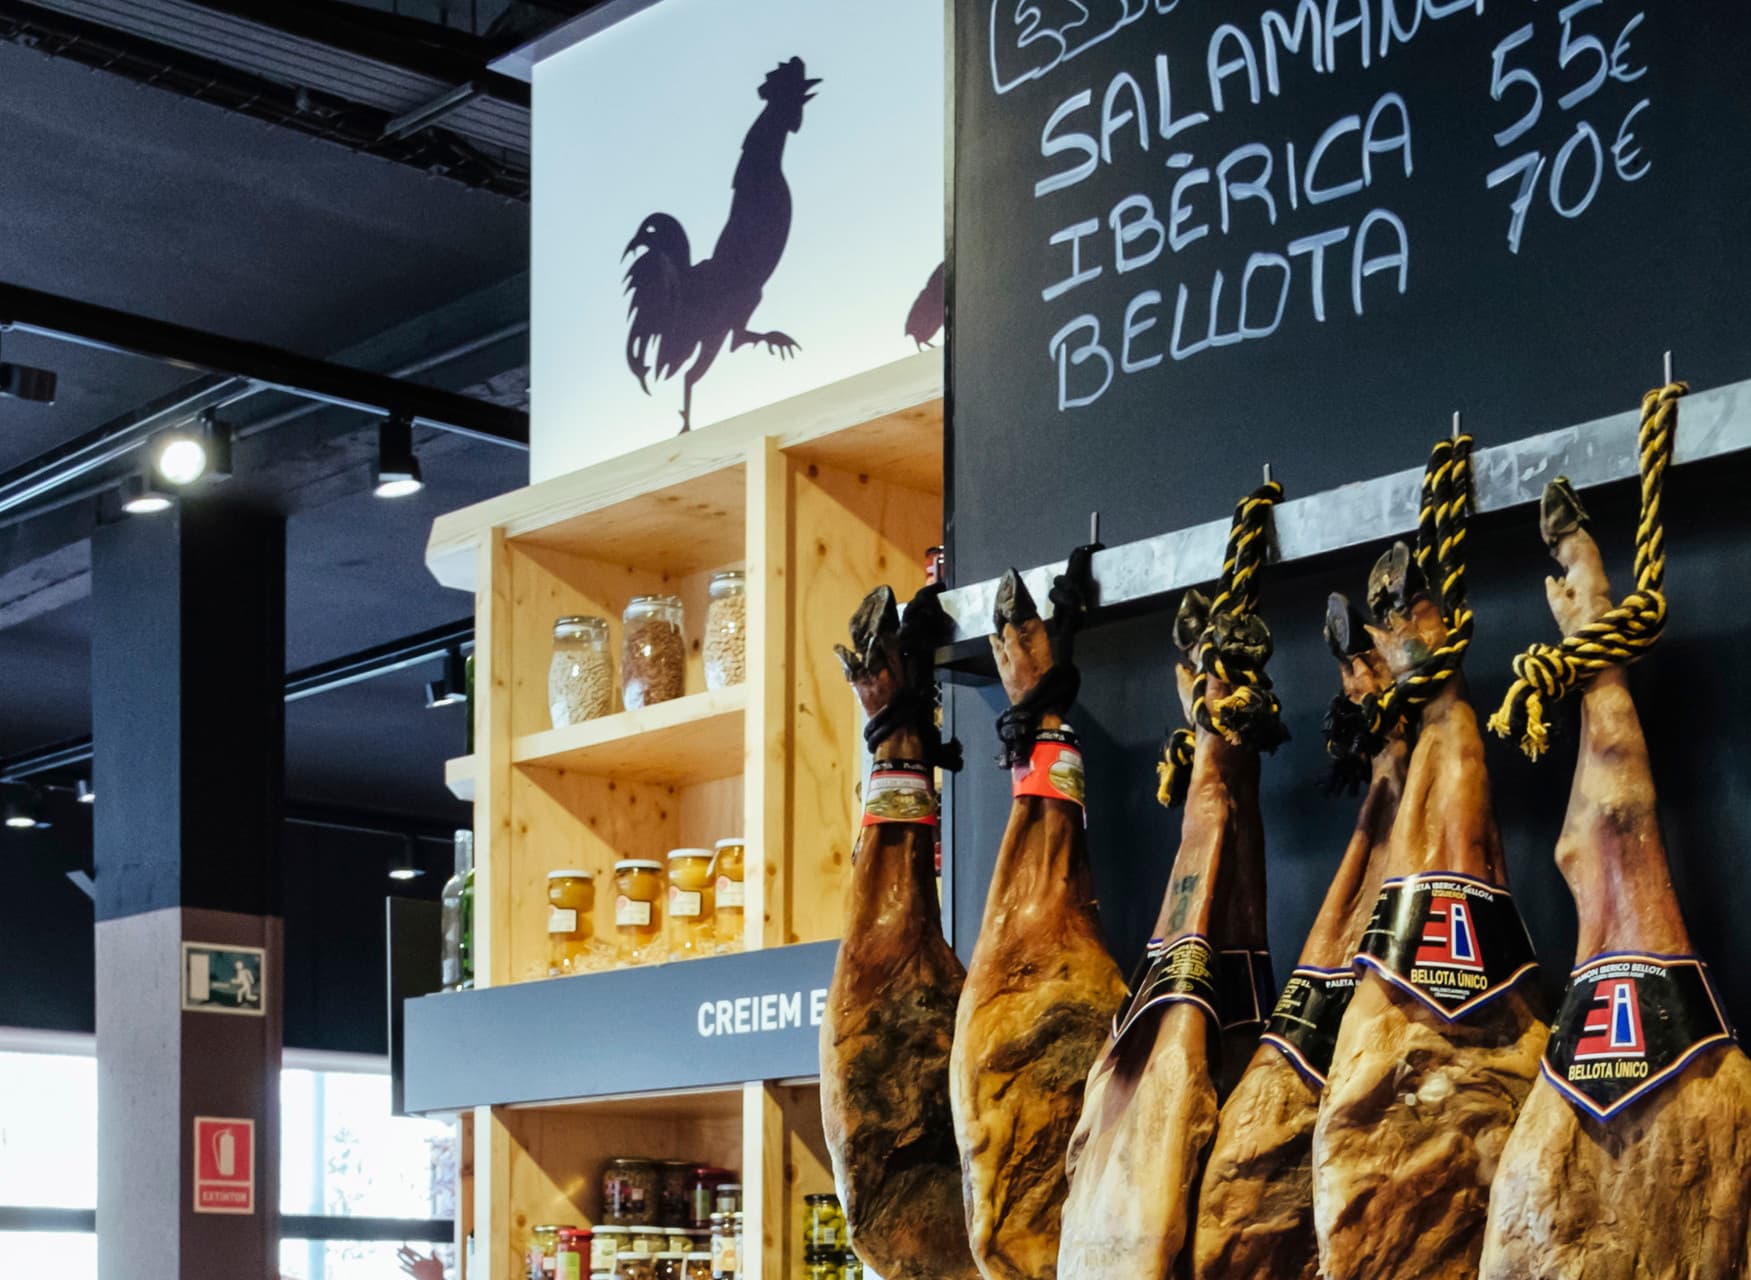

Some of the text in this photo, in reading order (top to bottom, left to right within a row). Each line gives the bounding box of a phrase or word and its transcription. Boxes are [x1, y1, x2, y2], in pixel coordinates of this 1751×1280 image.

[1490, 0, 1649, 148] 55€
[1035, 0, 1484, 197] SALAMAN
[1047, 98, 1653, 412] BELLOTA 70€
[1325, 978, 1354, 988] PALETA
[1410, 968, 1488, 990] BELLOTA ÚNICO
[1631, 963, 1667, 978] BELLOTA
[697, 990, 802, 1037] CREIEM
[1568, 1059, 1649, 1081] BELLOTA ÚNICO
